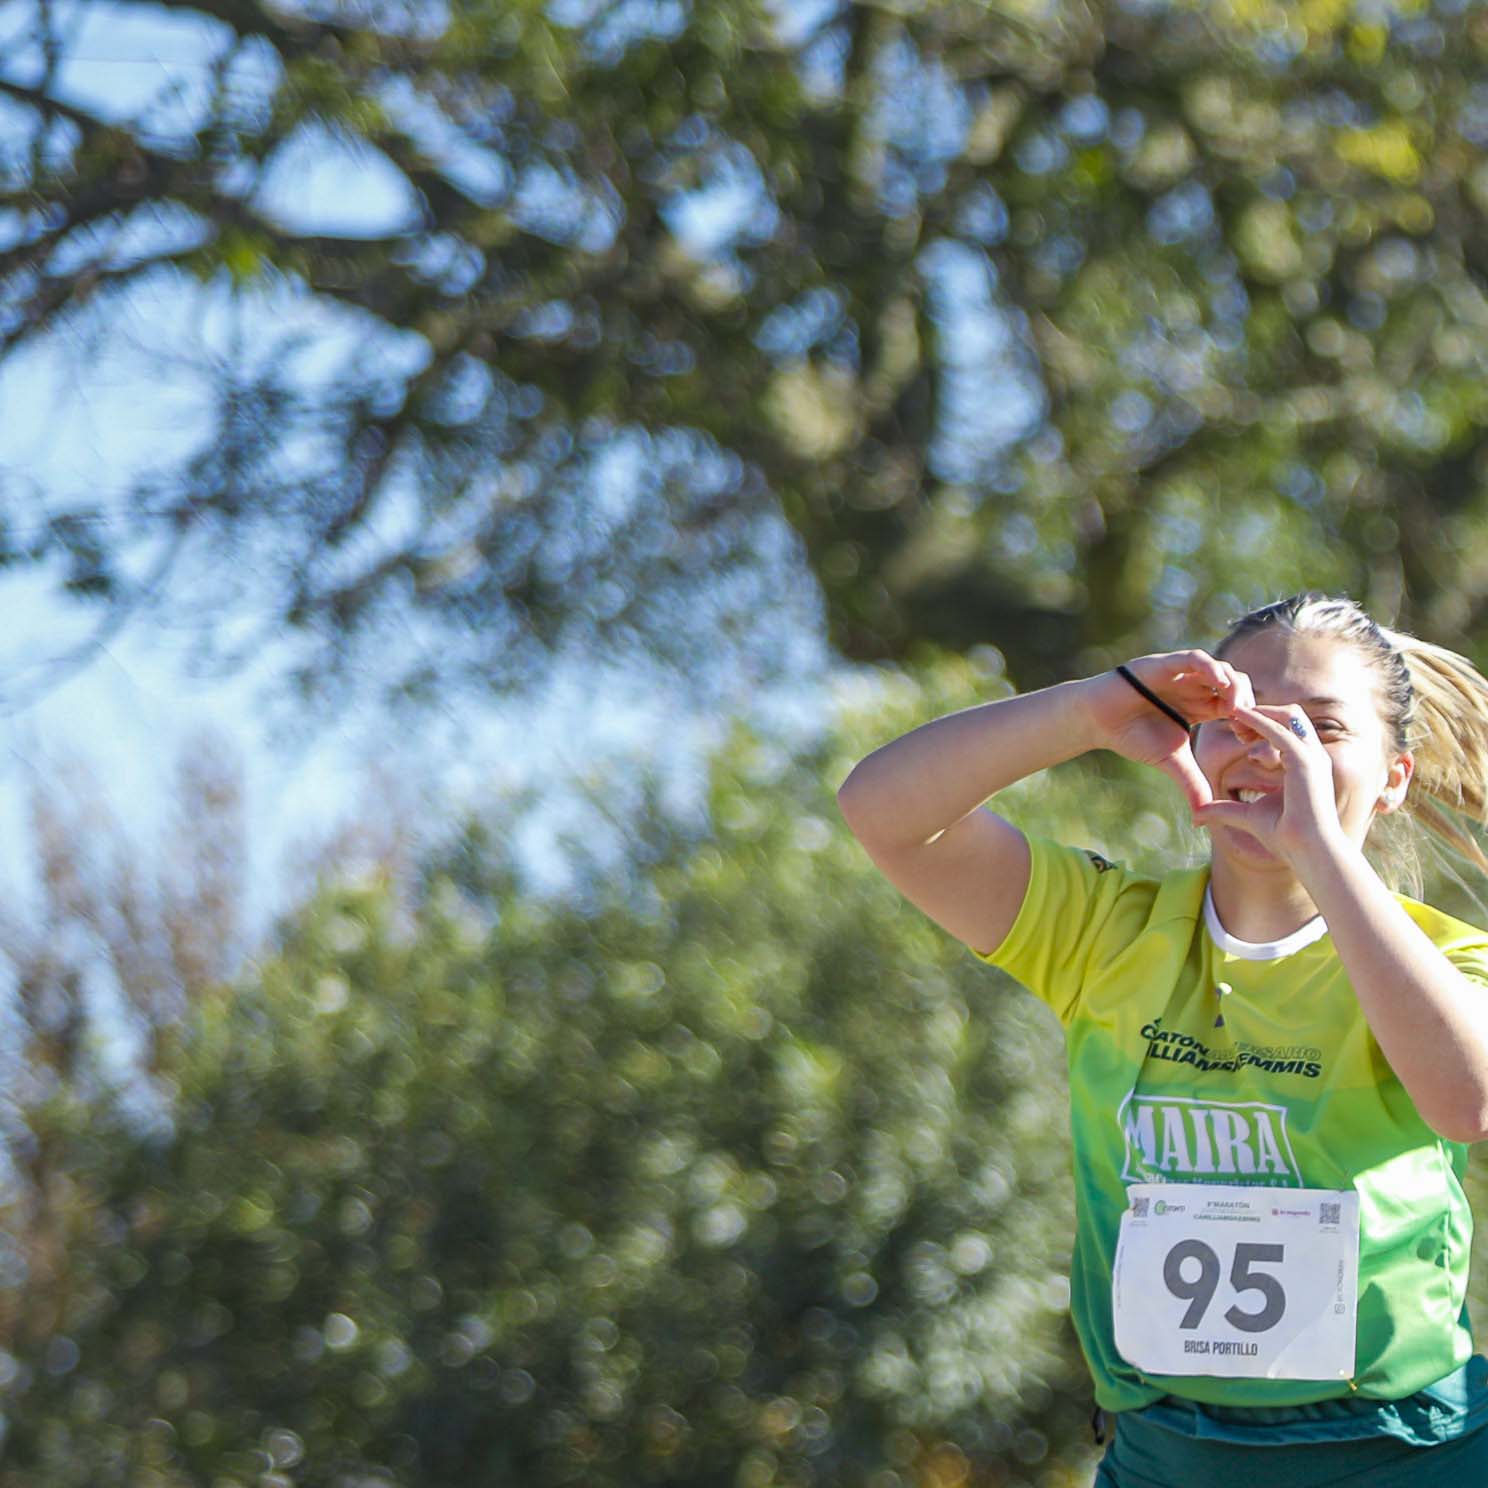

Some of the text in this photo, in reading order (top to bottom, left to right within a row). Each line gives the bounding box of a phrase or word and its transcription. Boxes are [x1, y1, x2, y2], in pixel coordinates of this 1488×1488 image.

[1163, 1239, 1286, 1333] 95
[1184, 1340, 1258, 1356] BRISA PORTILLO
